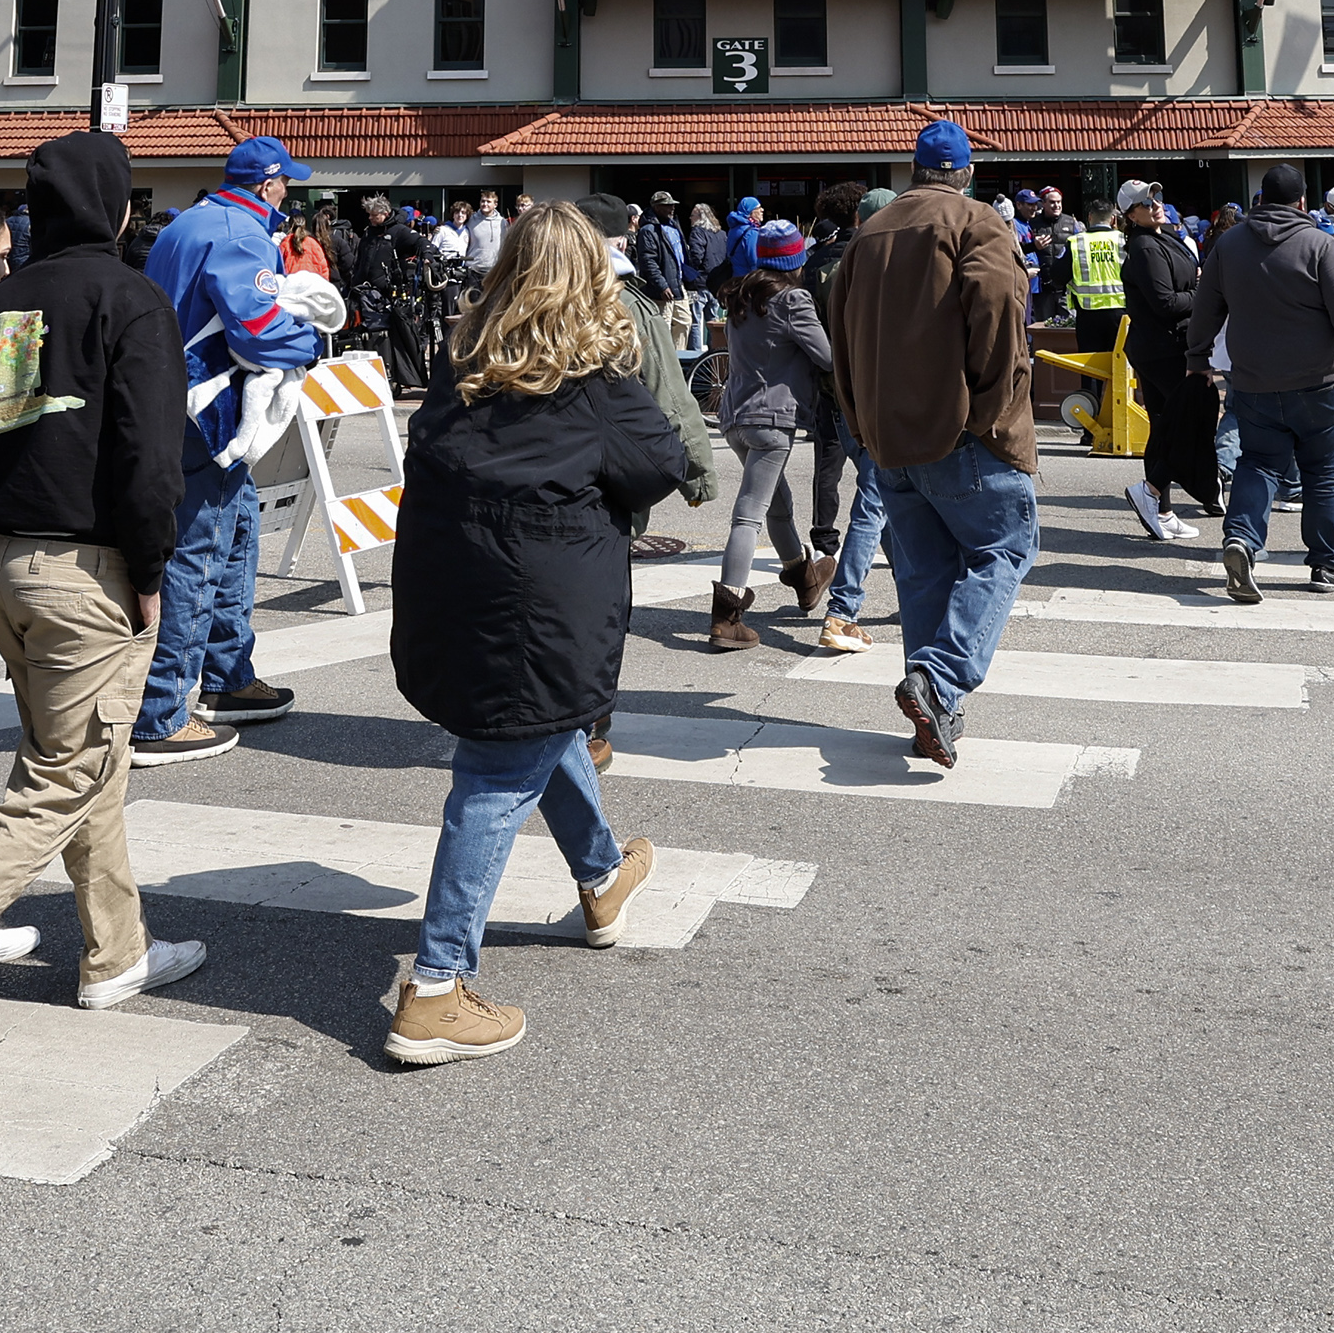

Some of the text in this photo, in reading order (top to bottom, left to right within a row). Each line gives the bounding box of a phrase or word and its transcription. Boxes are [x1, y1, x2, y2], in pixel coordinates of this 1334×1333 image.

[716, 40, 765, 50] GATE
[723, 51, 758, 82] 3
[1091, 251, 1115, 263] POLICE
